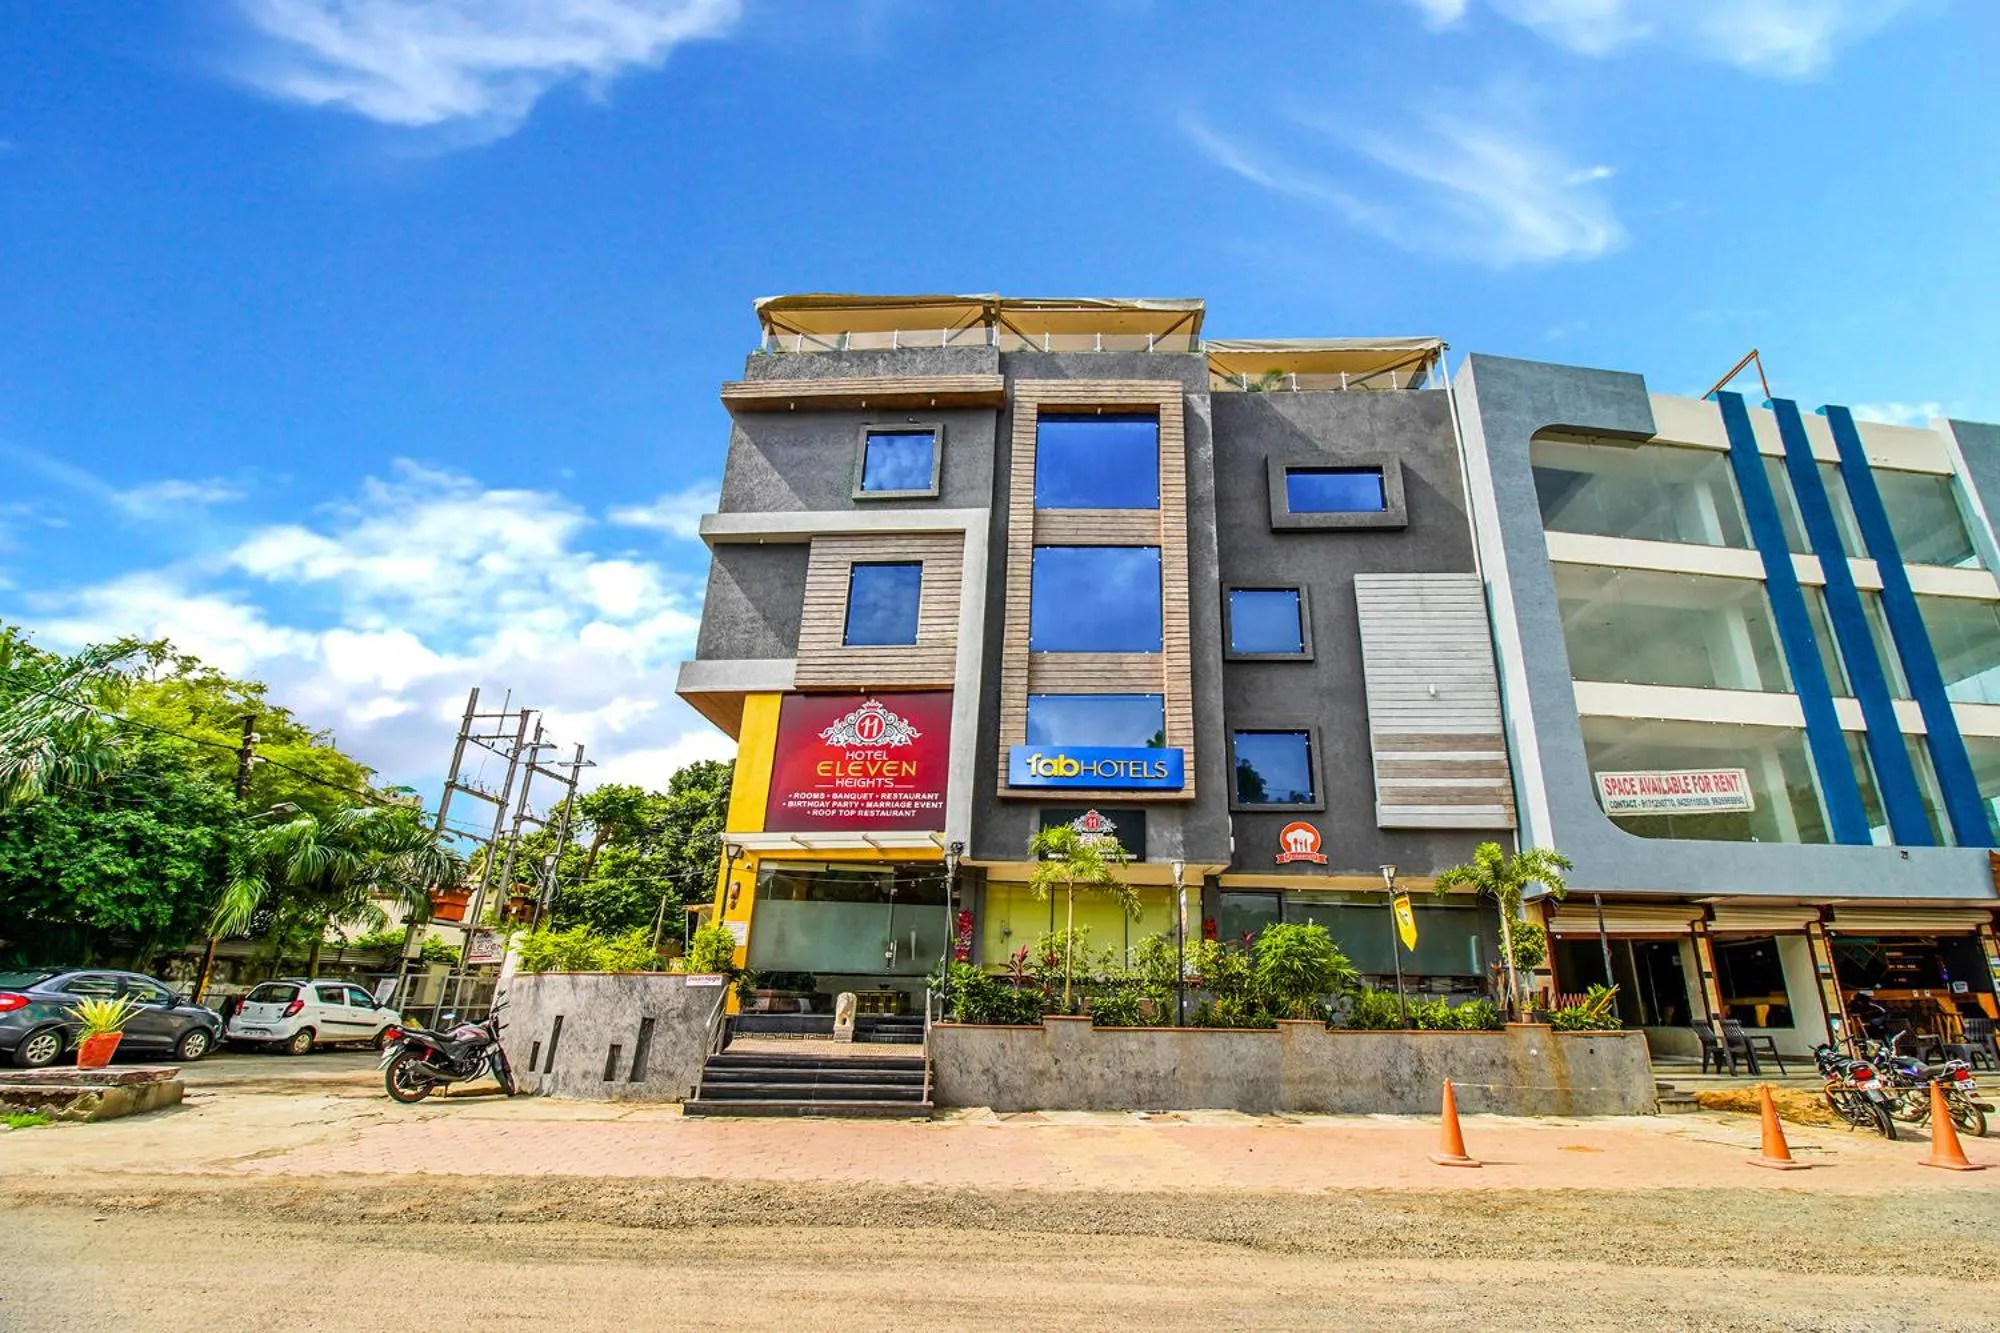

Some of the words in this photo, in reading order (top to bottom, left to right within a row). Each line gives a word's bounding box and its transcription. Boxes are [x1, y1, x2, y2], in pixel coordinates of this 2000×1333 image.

[861, 717, 879, 738] 11
[845, 750, 889, 761] HOTEL
[816, 760, 917, 777] ELEVEN
[835, 778, 895, 789] HEIGHTS
[1604, 777, 1638, 796] SPACE
[1640, 775, 1692, 795] AVAILABLE
[1691, 774, 1713, 793] FOR
[1712, 774, 1740, 793] RENT
[793, 792, 825, 800] ROOMS
[831, 792, 874, 800] BANQUET
[881, 792, 939, 800] RESTAURANT
[914, 801, 944, 809] EVENT
[838, 809, 856, 817] TOP
[857, 809, 917, 817] RESTAURANT
